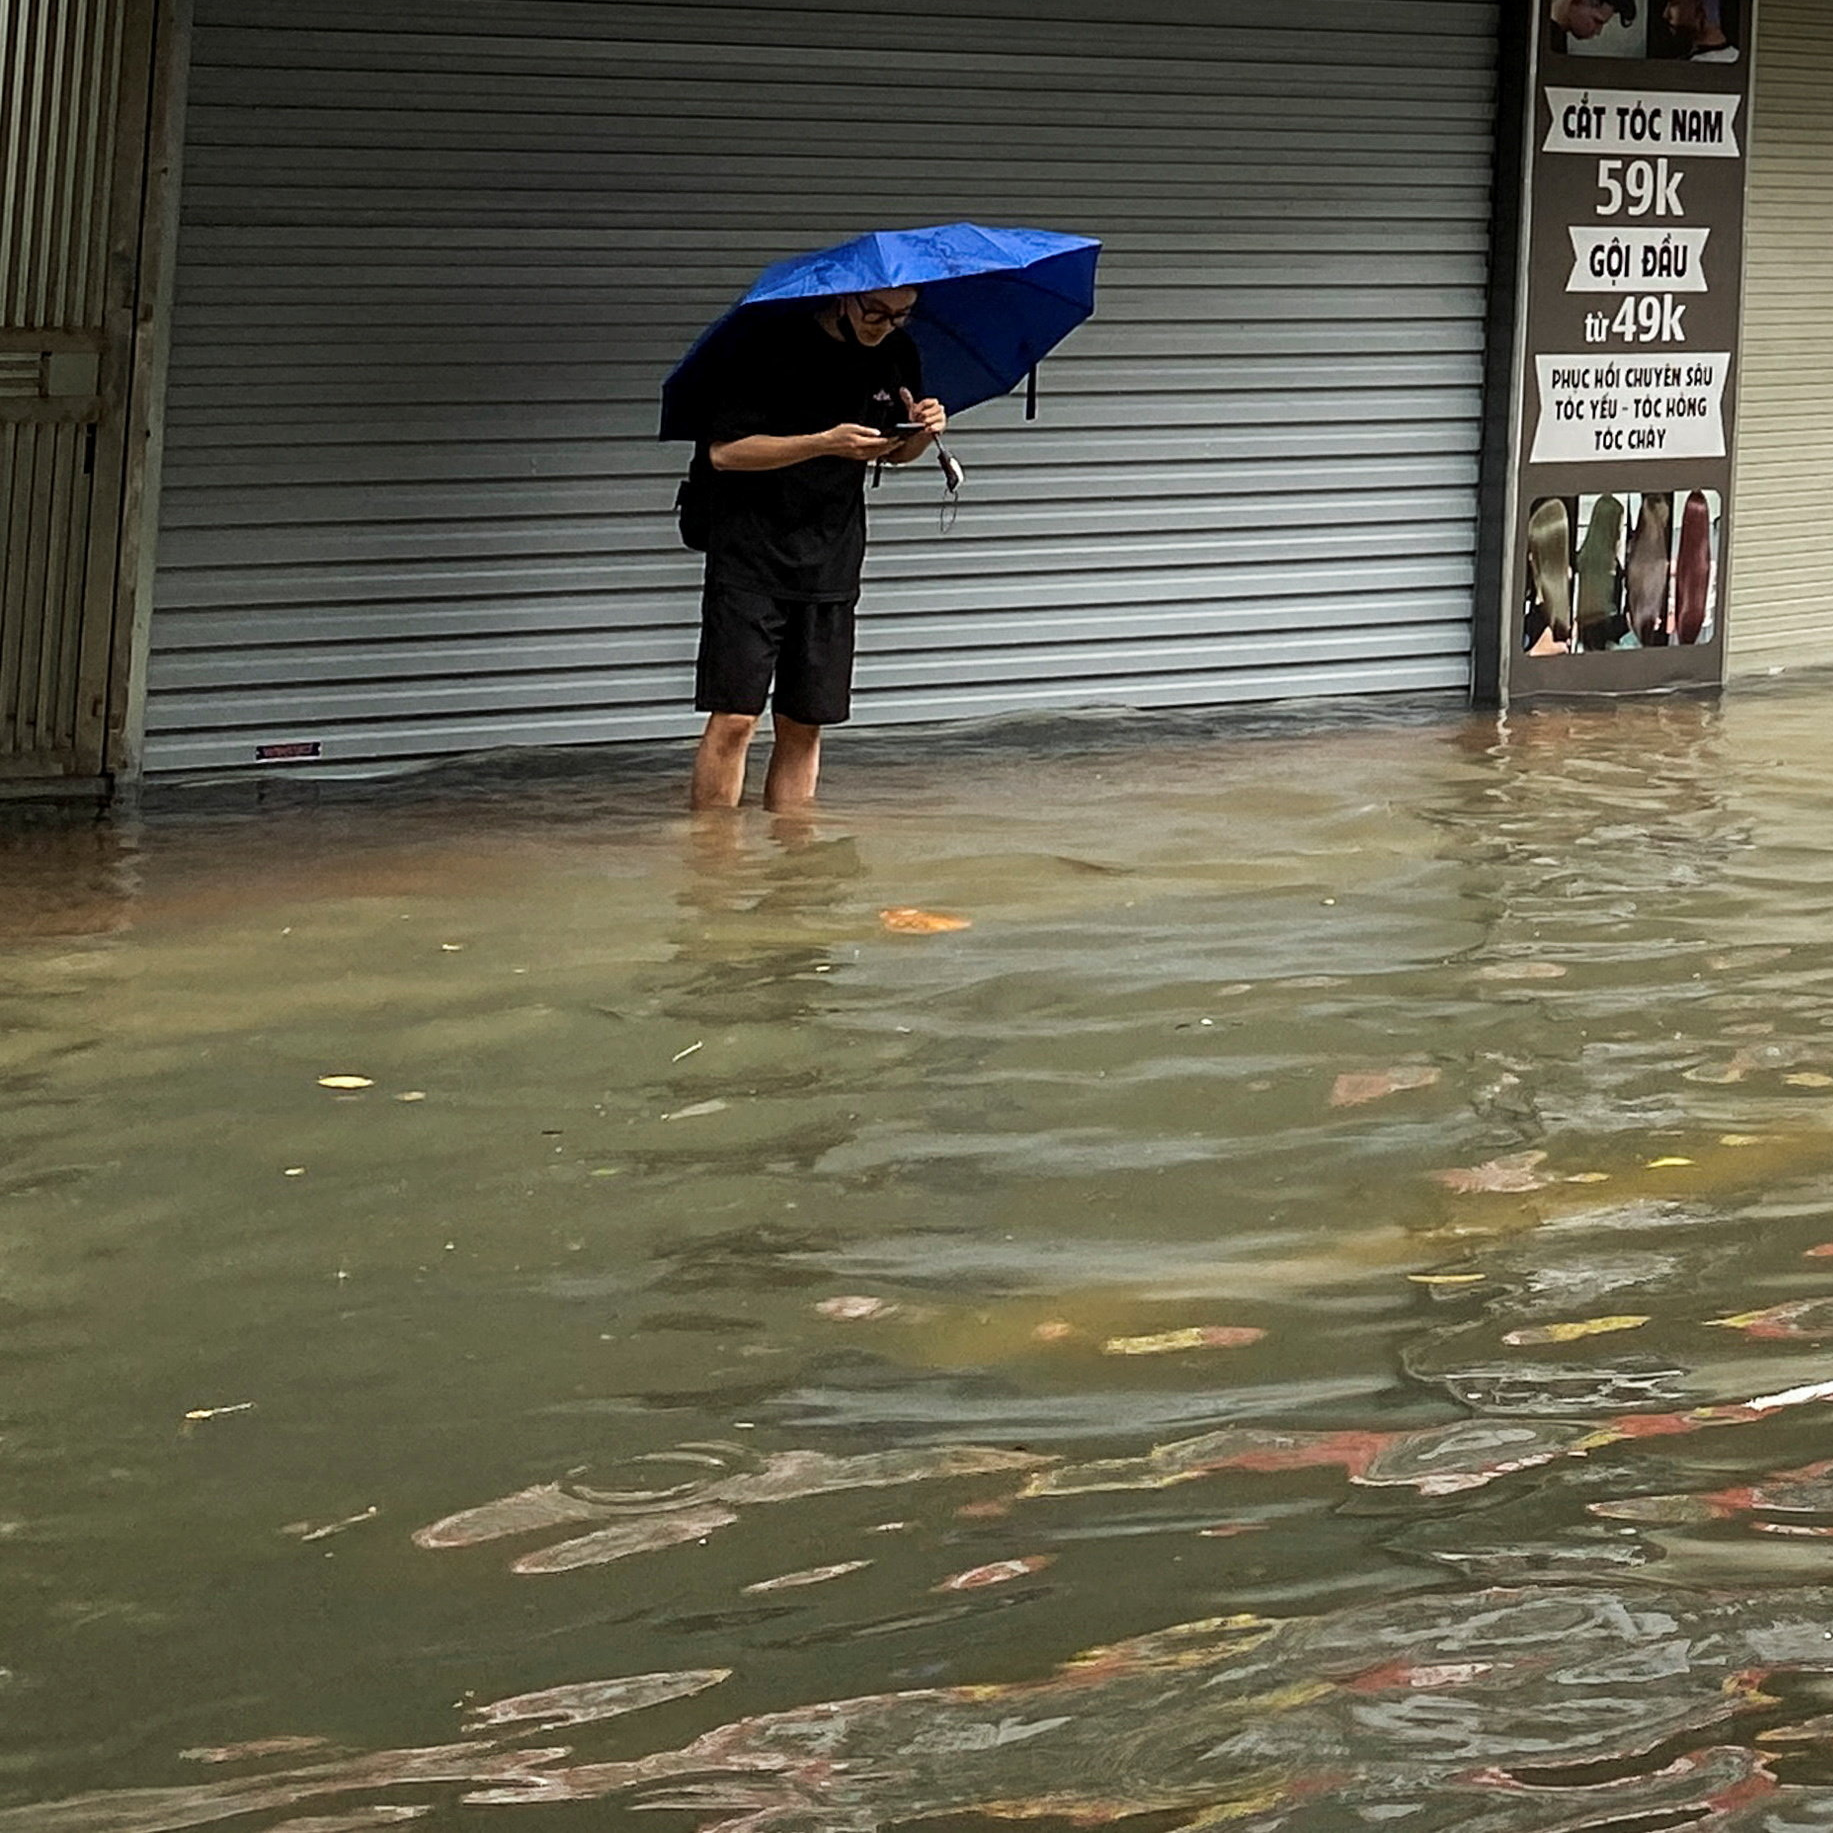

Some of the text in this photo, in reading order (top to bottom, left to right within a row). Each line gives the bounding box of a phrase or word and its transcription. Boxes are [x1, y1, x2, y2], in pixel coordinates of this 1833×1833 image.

[1562, 91, 1723, 144] CẮT TÓC NAM
[1595, 158, 1685, 217] 59k
[1589, 233, 1688, 286] GỘI ĐẦU
[1584, 294, 1687, 344] từ 49k
[1551, 360, 1713, 395] PHỤC HỒI CHUYÊN SÂU
[1555, 391, 1662, 420] TÓC YẾU TÓC
[1594, 424, 1667, 451] TÓC CHÁY
